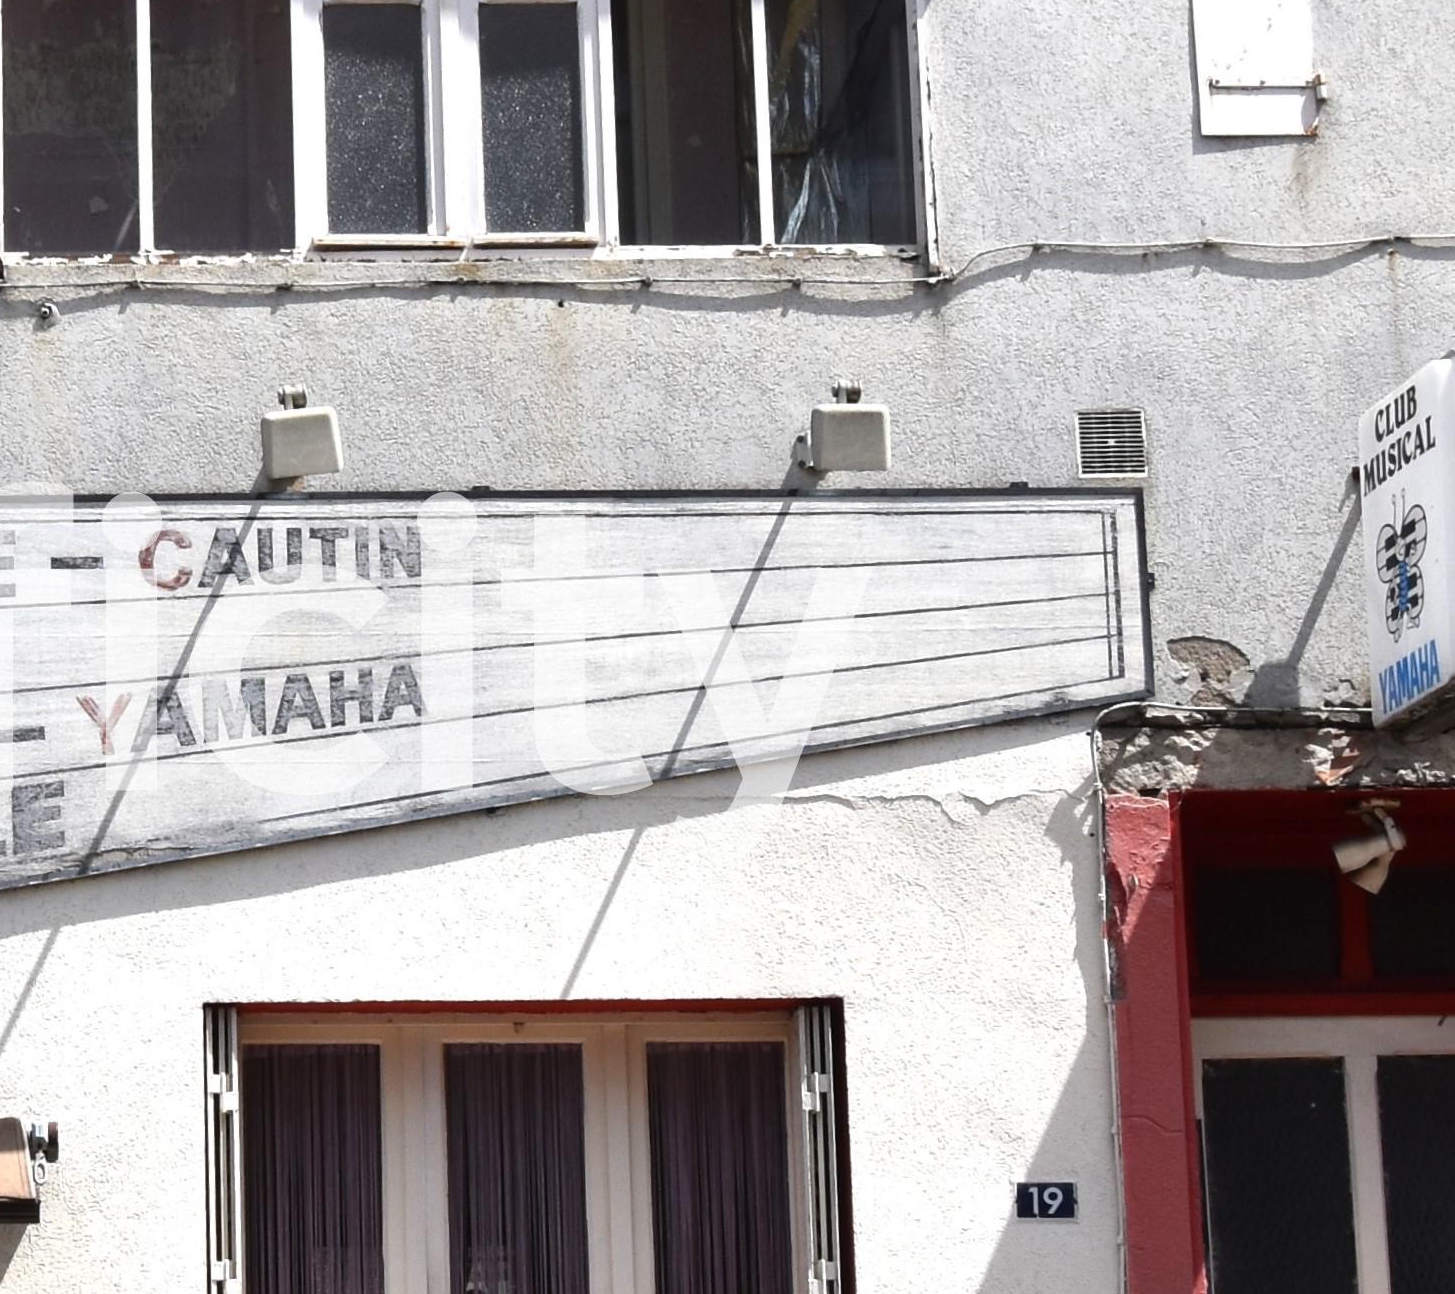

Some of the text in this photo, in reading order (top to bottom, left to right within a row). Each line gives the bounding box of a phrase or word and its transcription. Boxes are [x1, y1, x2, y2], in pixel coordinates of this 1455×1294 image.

[1375, 385, 1417, 443] CLUB
[1363, 415, 1436, 497] MUSICAL
[139, 526, 422, 591] CAUTIN
[77, 664, 428, 755] YAMAHA
[1379, 639, 1440, 714] YAMAHA
[1028, 1187, 1063, 1215] 19
